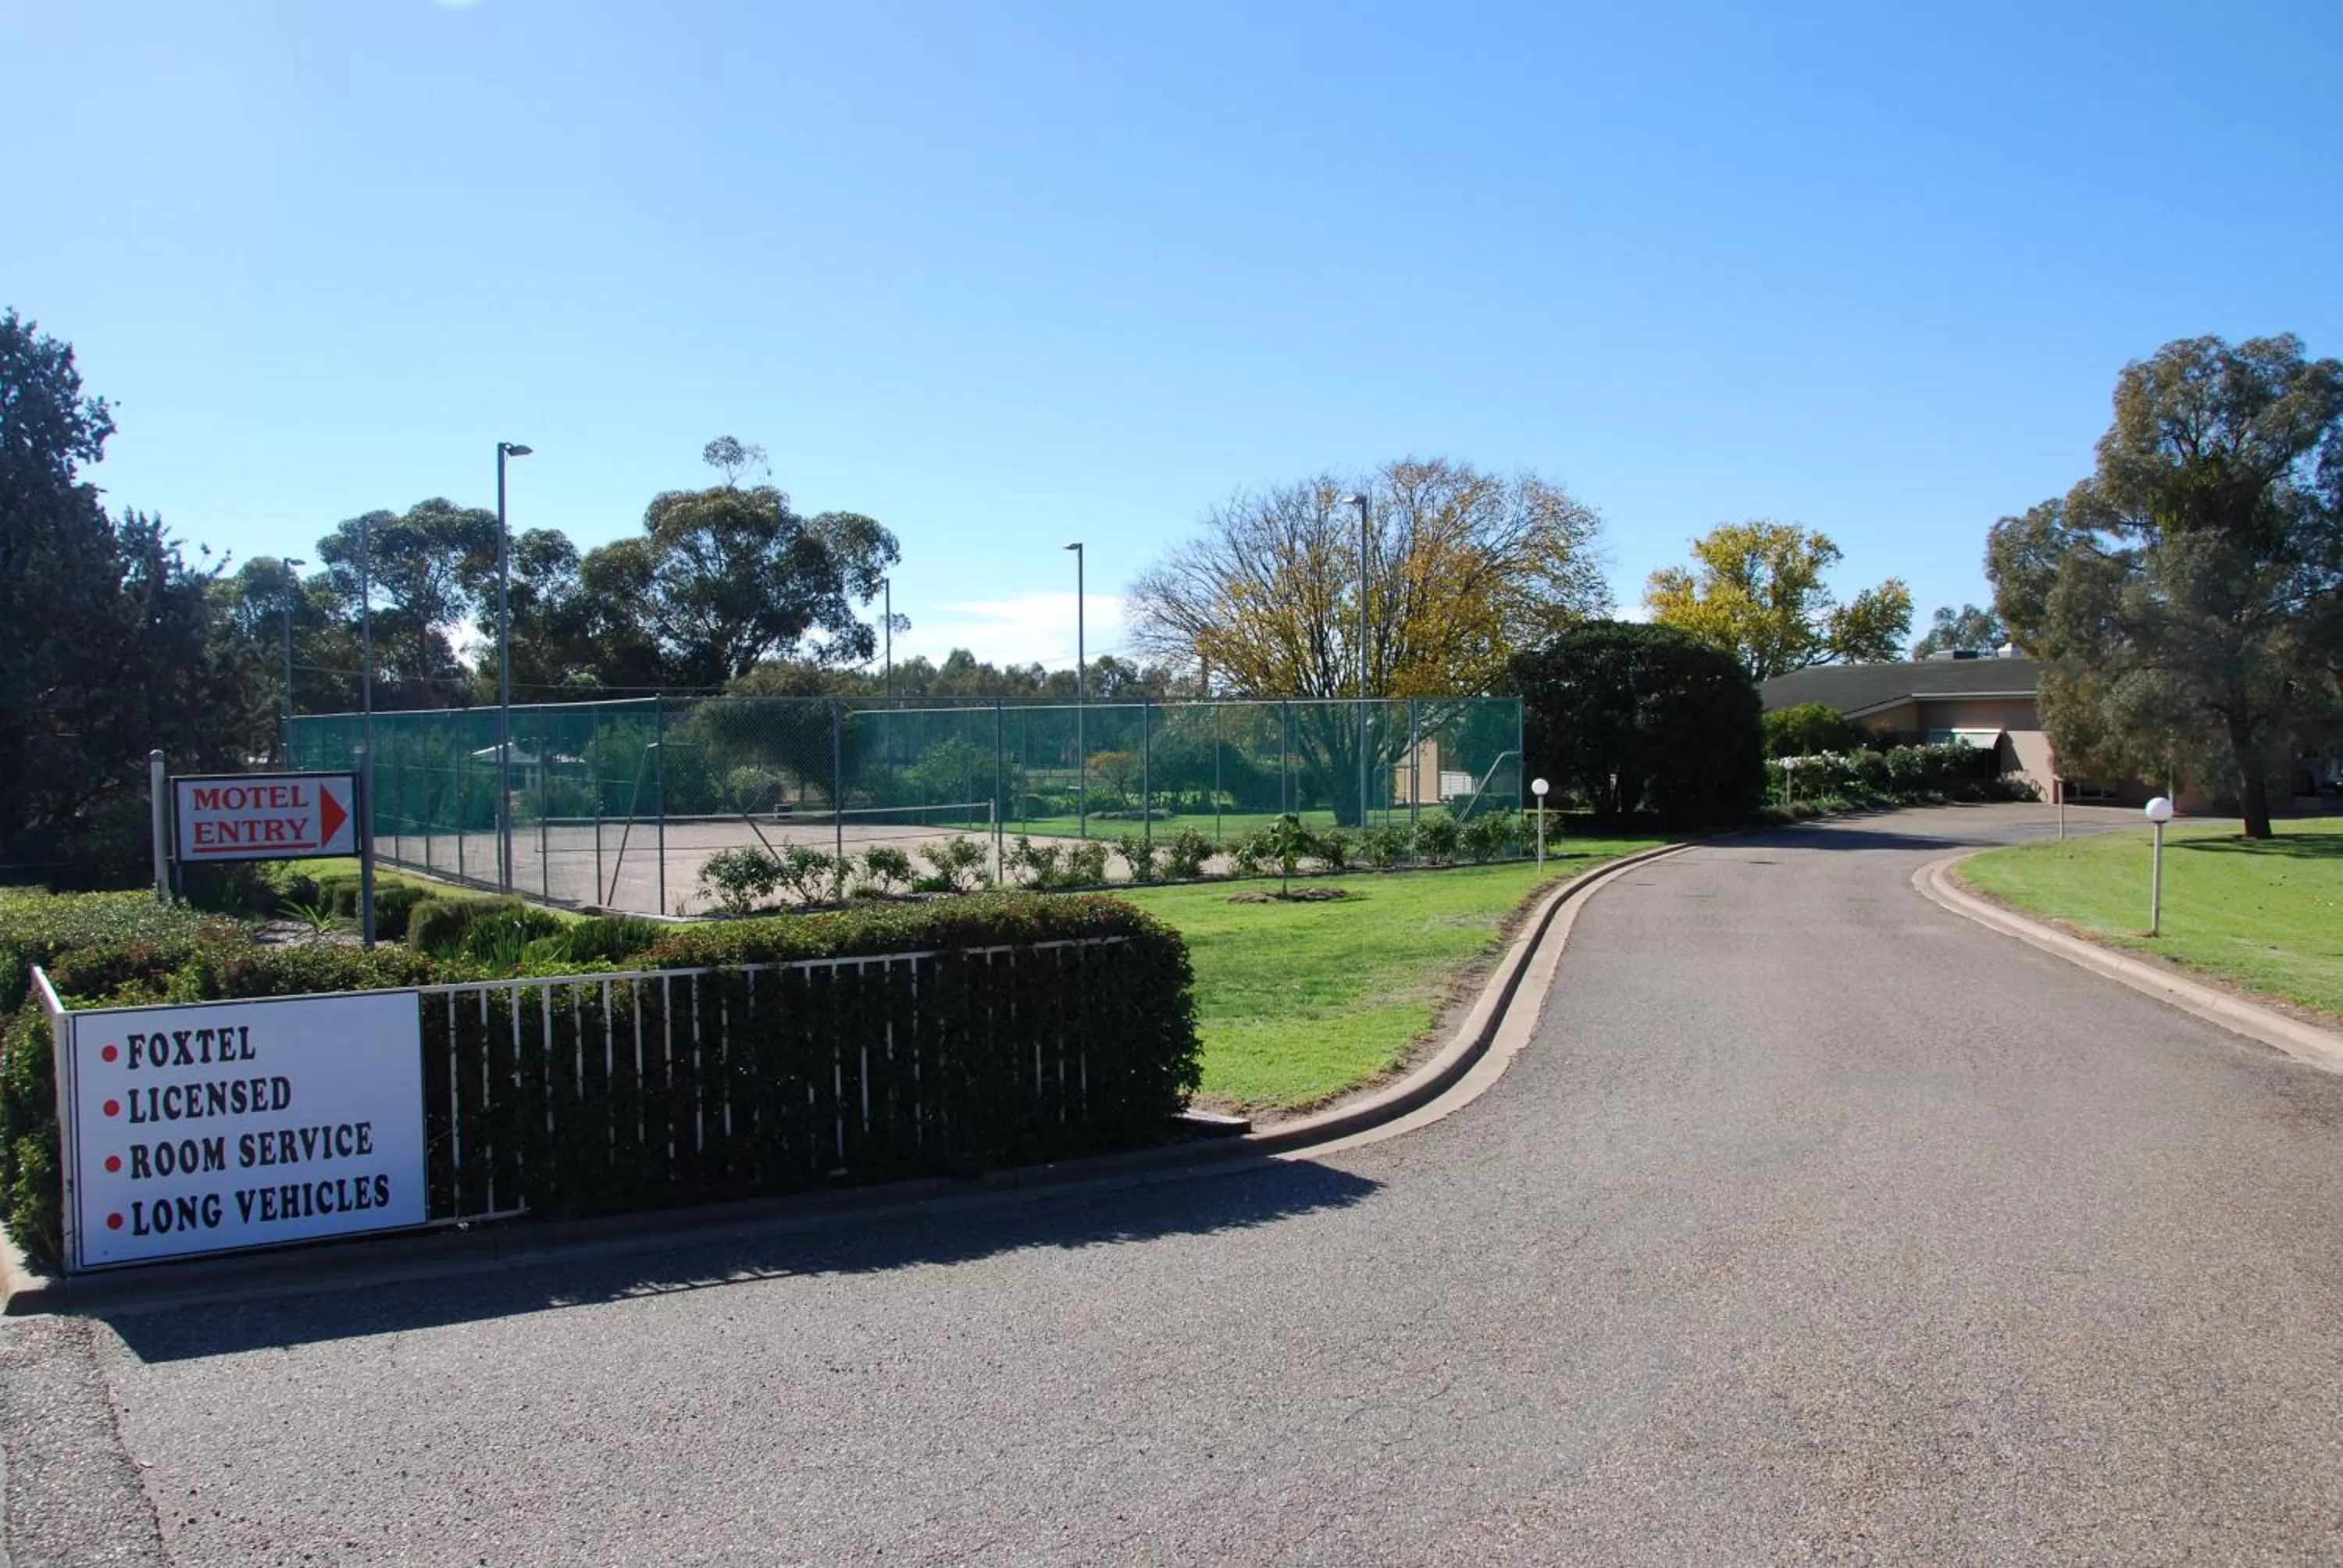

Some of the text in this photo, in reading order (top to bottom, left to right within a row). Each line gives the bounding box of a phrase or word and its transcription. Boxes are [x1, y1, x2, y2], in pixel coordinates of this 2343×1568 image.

[193, 786, 309, 811] MOTEL
[193, 818, 308, 844] ENTRY
[127, 1026, 256, 1070] FOXTEL
[128, 1076, 292, 1124] LICENSED
[130, 1121, 373, 1179] ROOM SERVICE
[131, 1174, 390, 1236] LONG VEHICLES
